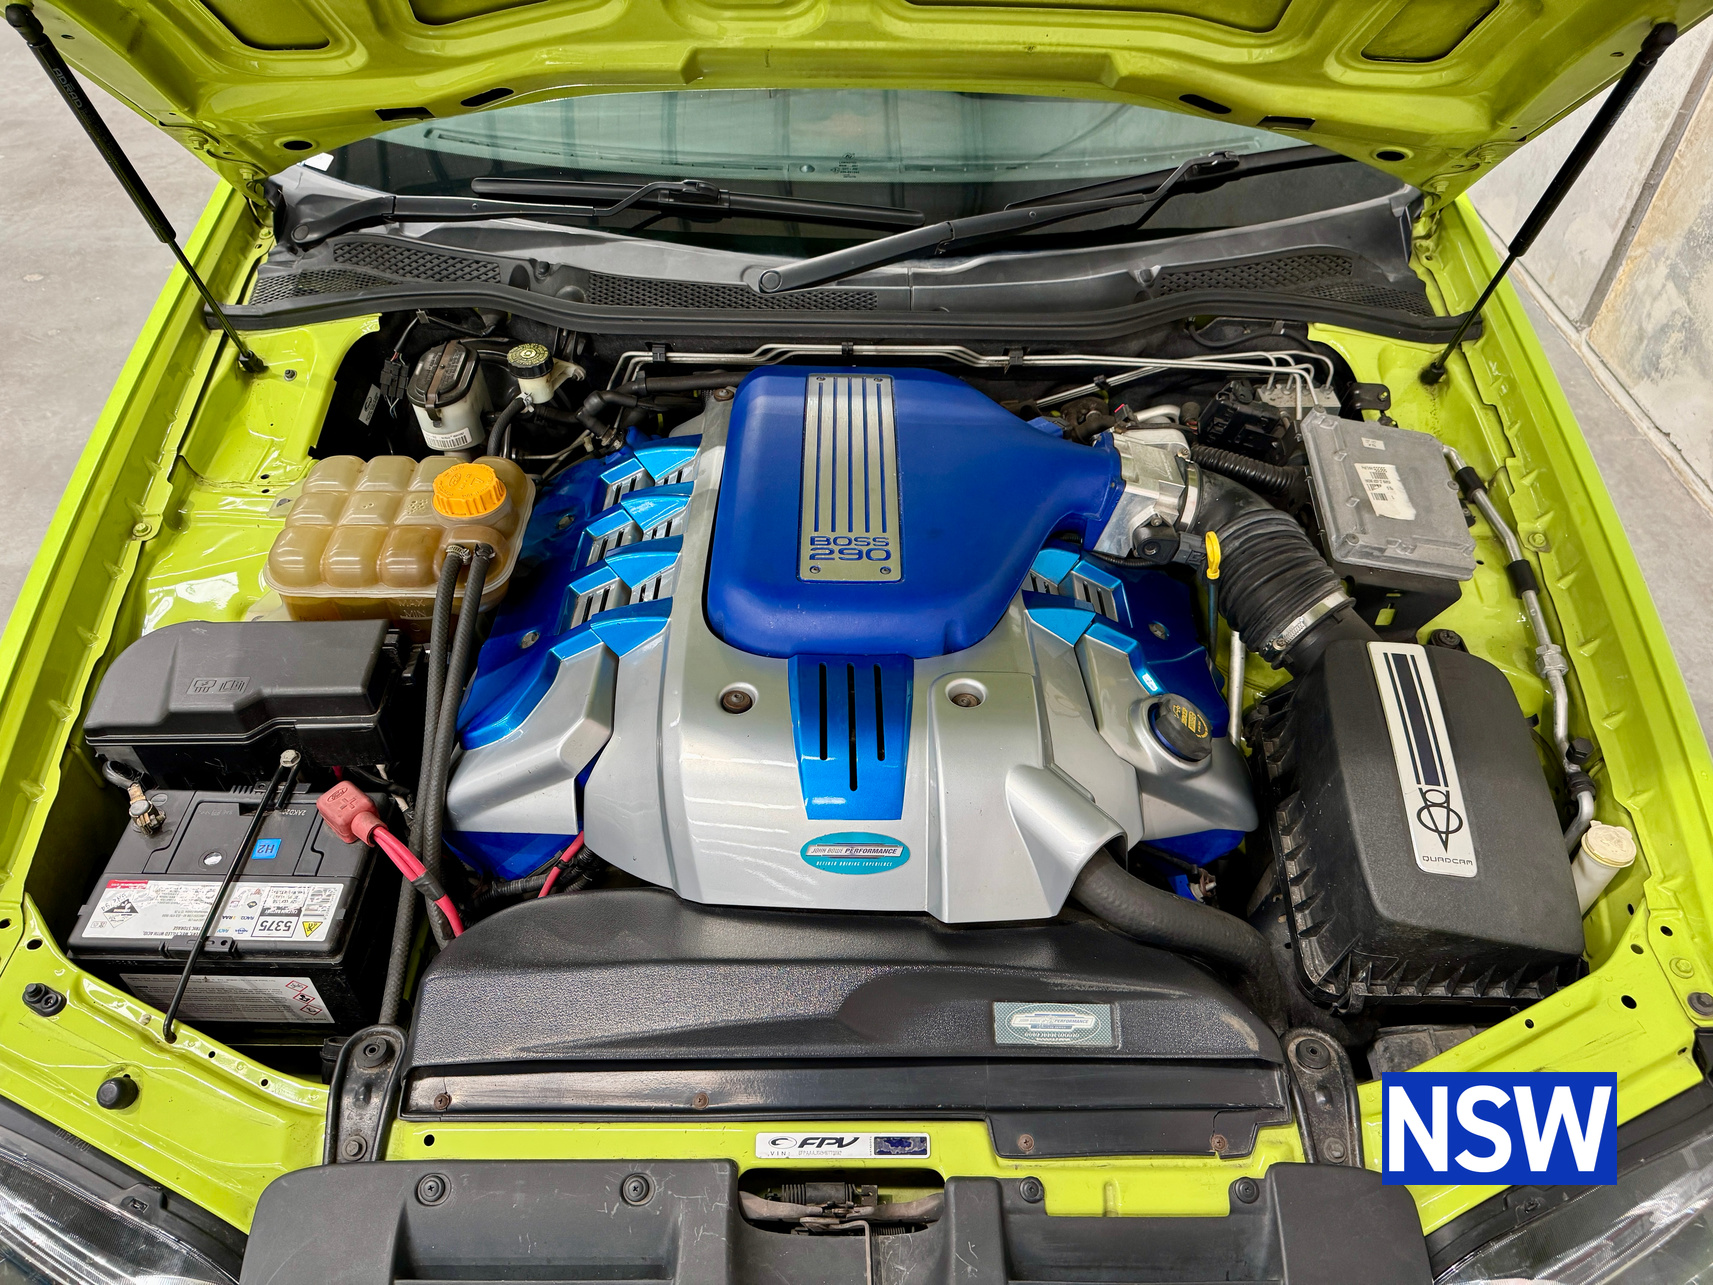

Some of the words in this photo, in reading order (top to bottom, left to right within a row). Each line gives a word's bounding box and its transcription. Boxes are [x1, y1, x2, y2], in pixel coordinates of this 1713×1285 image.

[53, 67, 82, 108] ADRAD
[809, 535, 890, 547] BOSS
[809, 547, 892, 561] 290
[256, 844, 275, 854] H2
[844, 847, 898, 855] PERFORMANCE
[1422, 855, 1474, 866] QUADCAM
[258, 920, 293, 932] 5375
[797, 1136, 861, 1149] FPV
